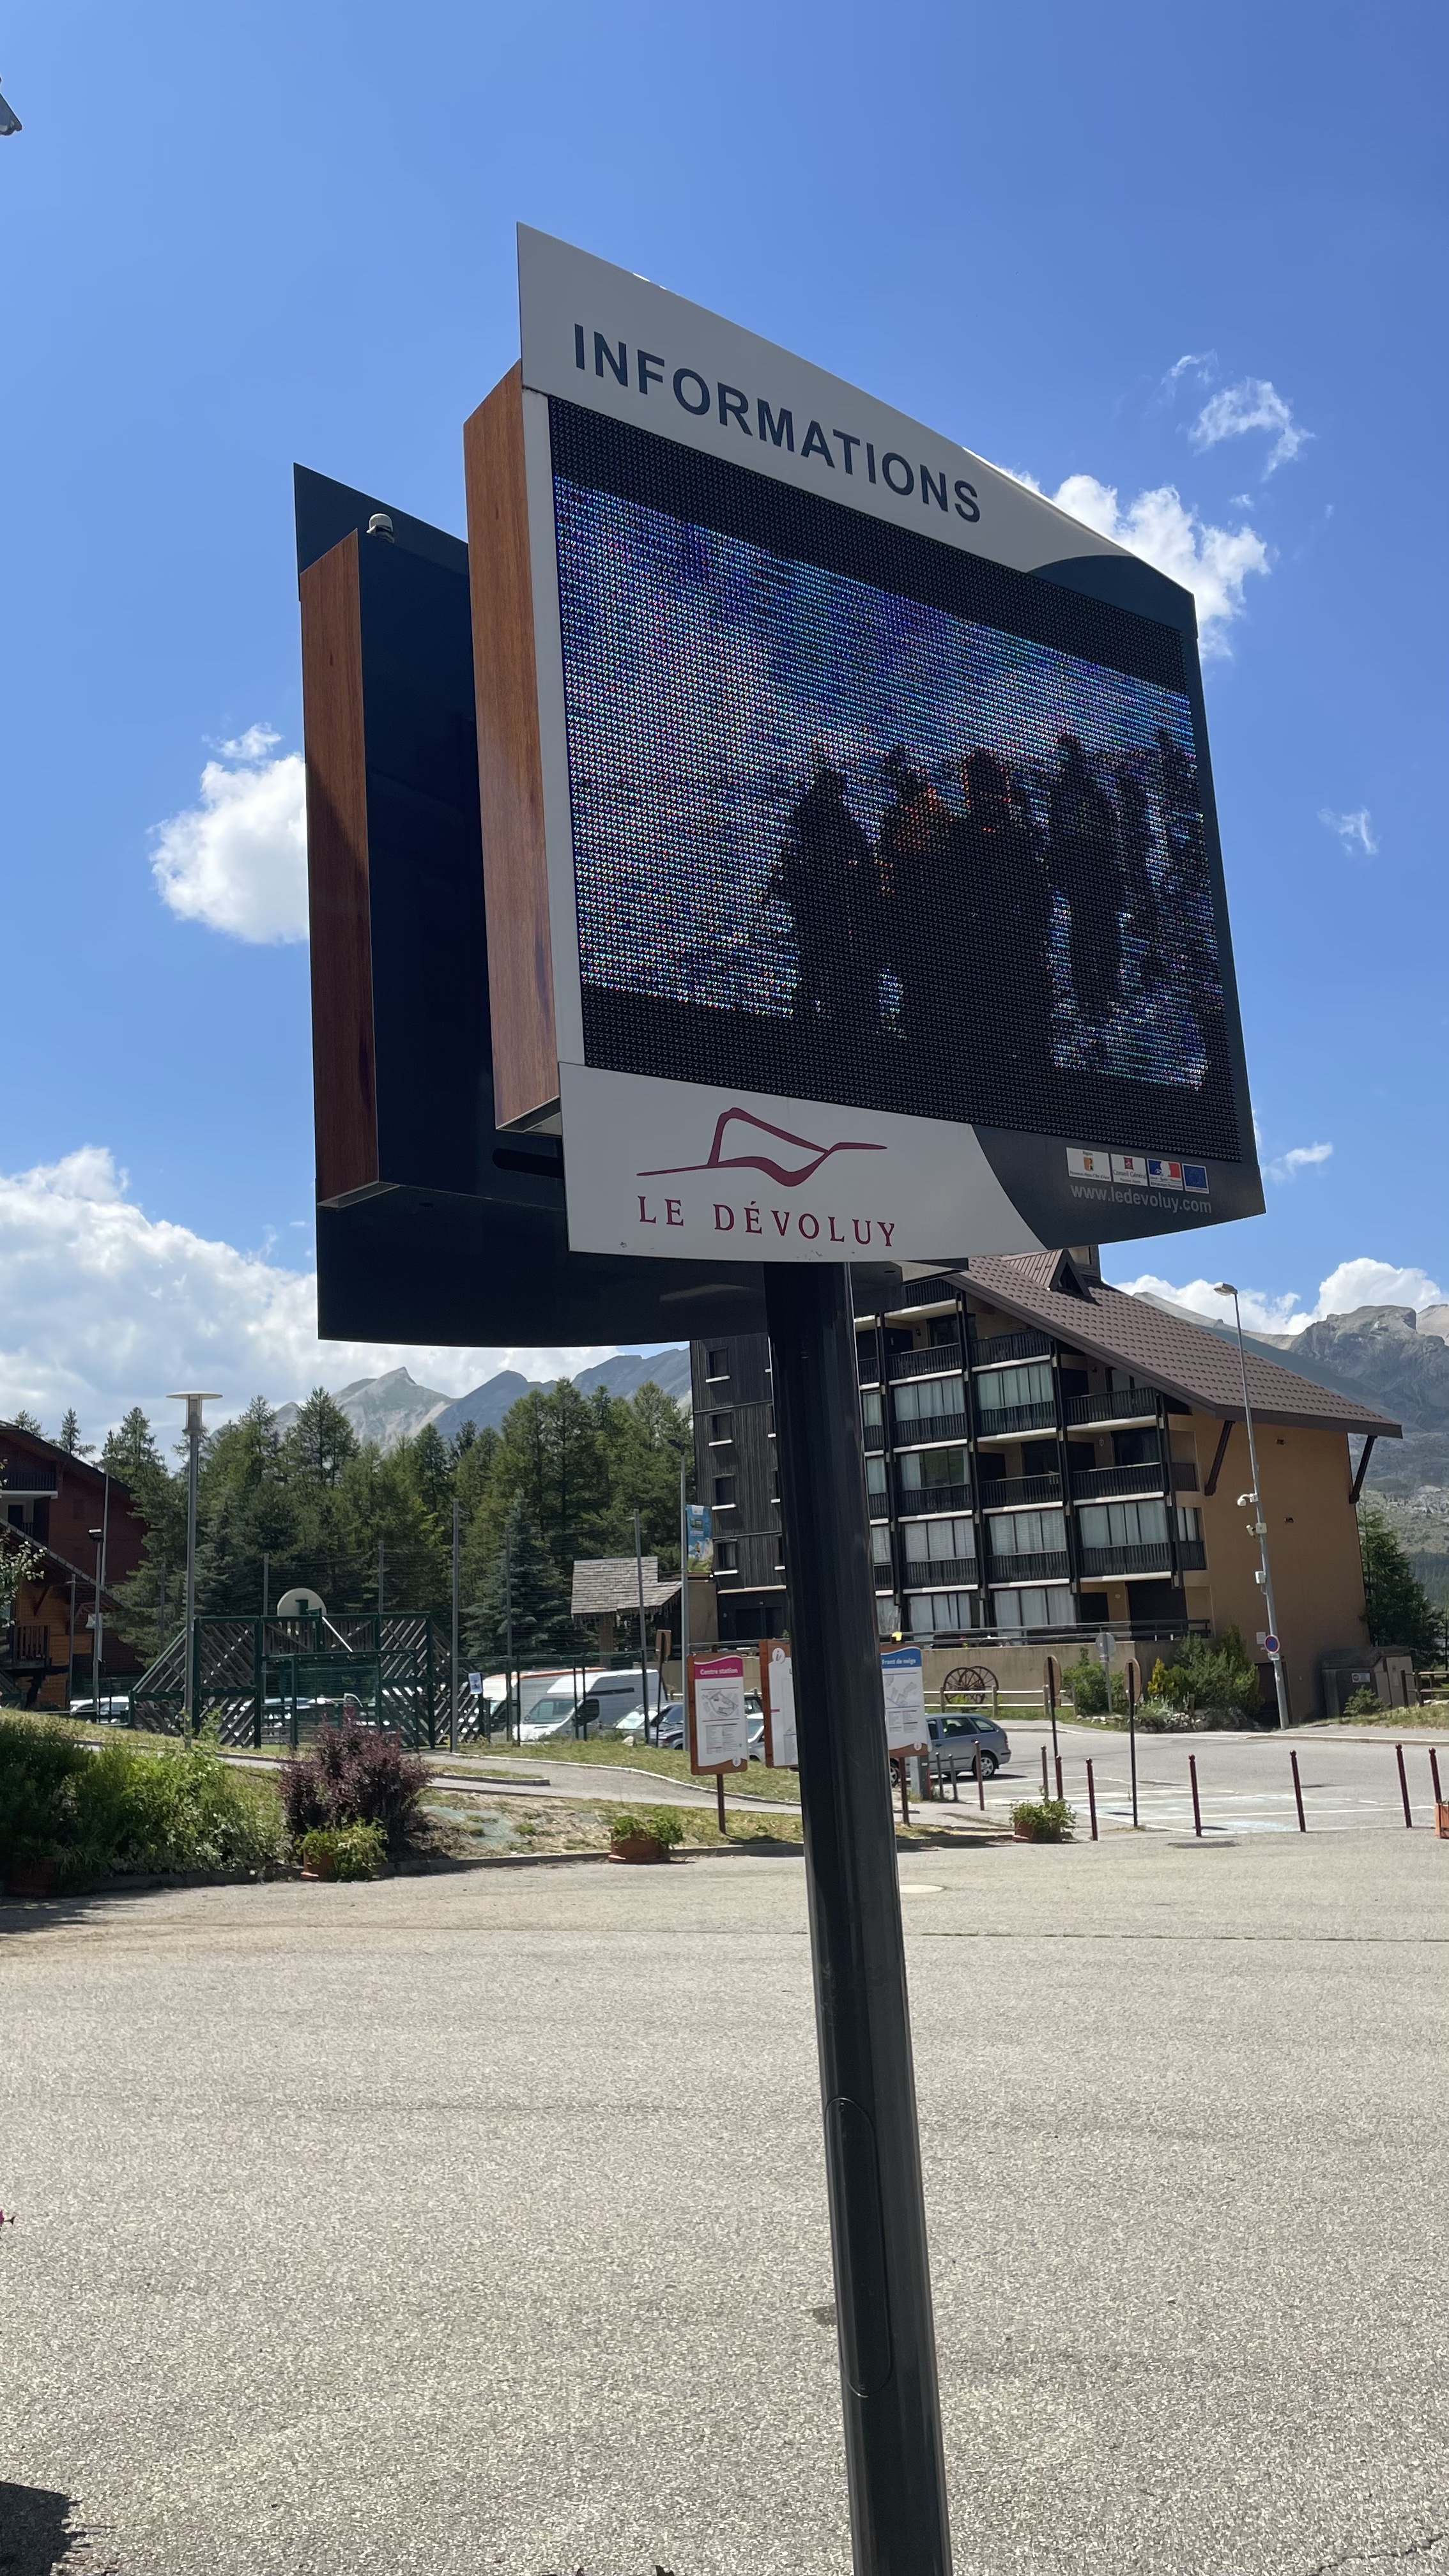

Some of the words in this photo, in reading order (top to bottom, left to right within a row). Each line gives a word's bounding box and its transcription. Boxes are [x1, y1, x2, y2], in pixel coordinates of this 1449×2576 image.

[574, 323, 981, 523] INFORMATIONS
[637, 1195, 684, 1227] LE
[712, 1200, 895, 1246] DÉVOLUY
[1070, 1185, 1212, 1214] www.ledevoluy.com
